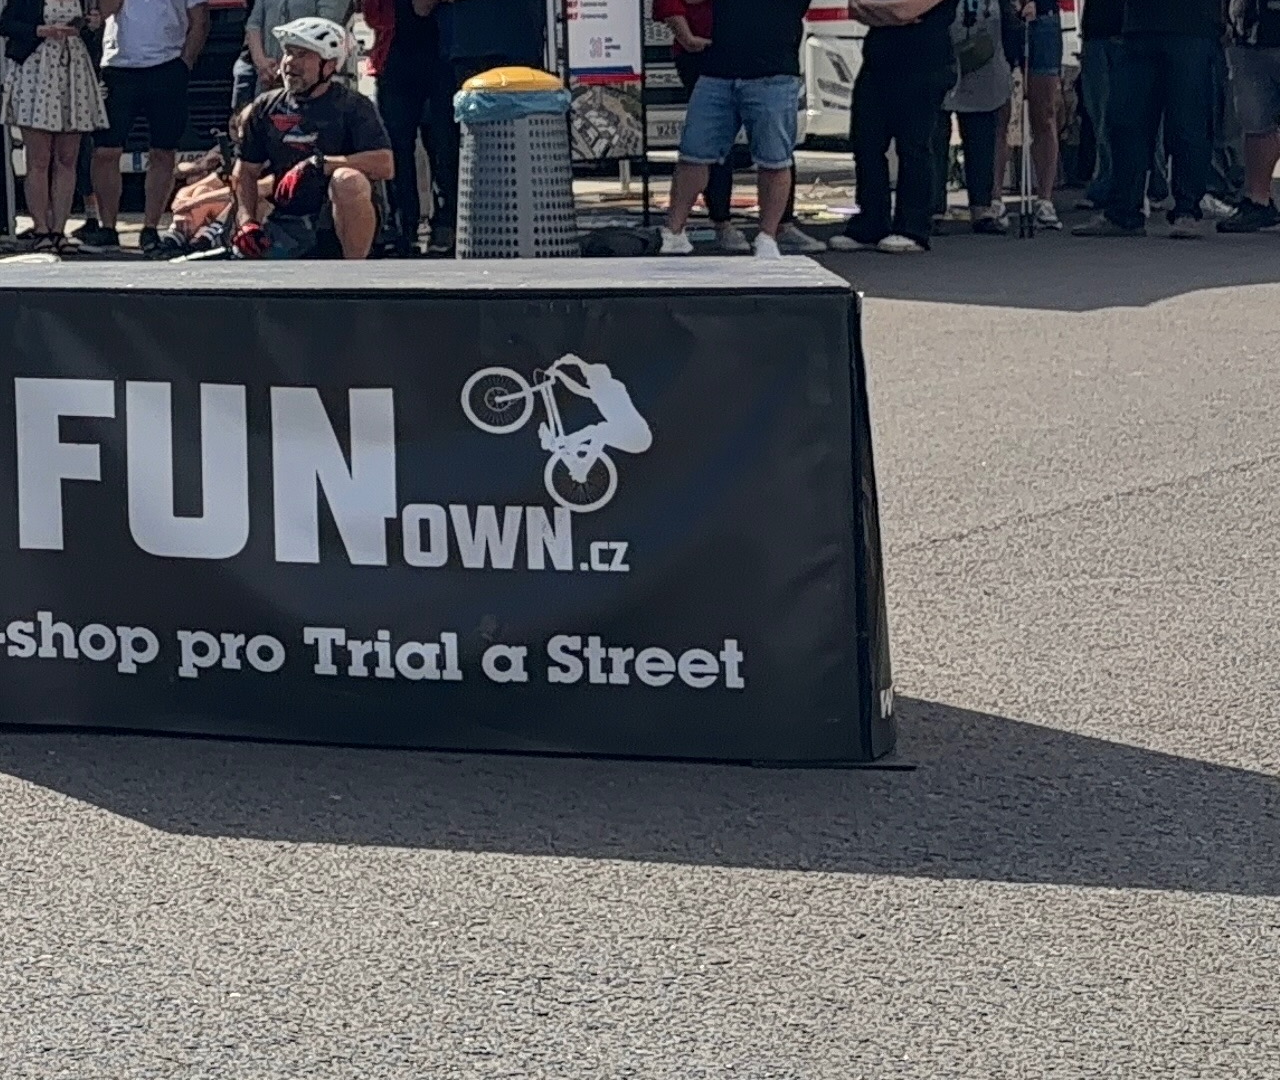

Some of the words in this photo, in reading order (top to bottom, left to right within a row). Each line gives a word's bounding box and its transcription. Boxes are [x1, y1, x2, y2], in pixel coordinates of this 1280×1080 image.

[177, 628, 285, 678] pro
[303, 626, 463, 682] Trial
[481, 641, 528, 682] a
[547, 634, 745, 689] Street
